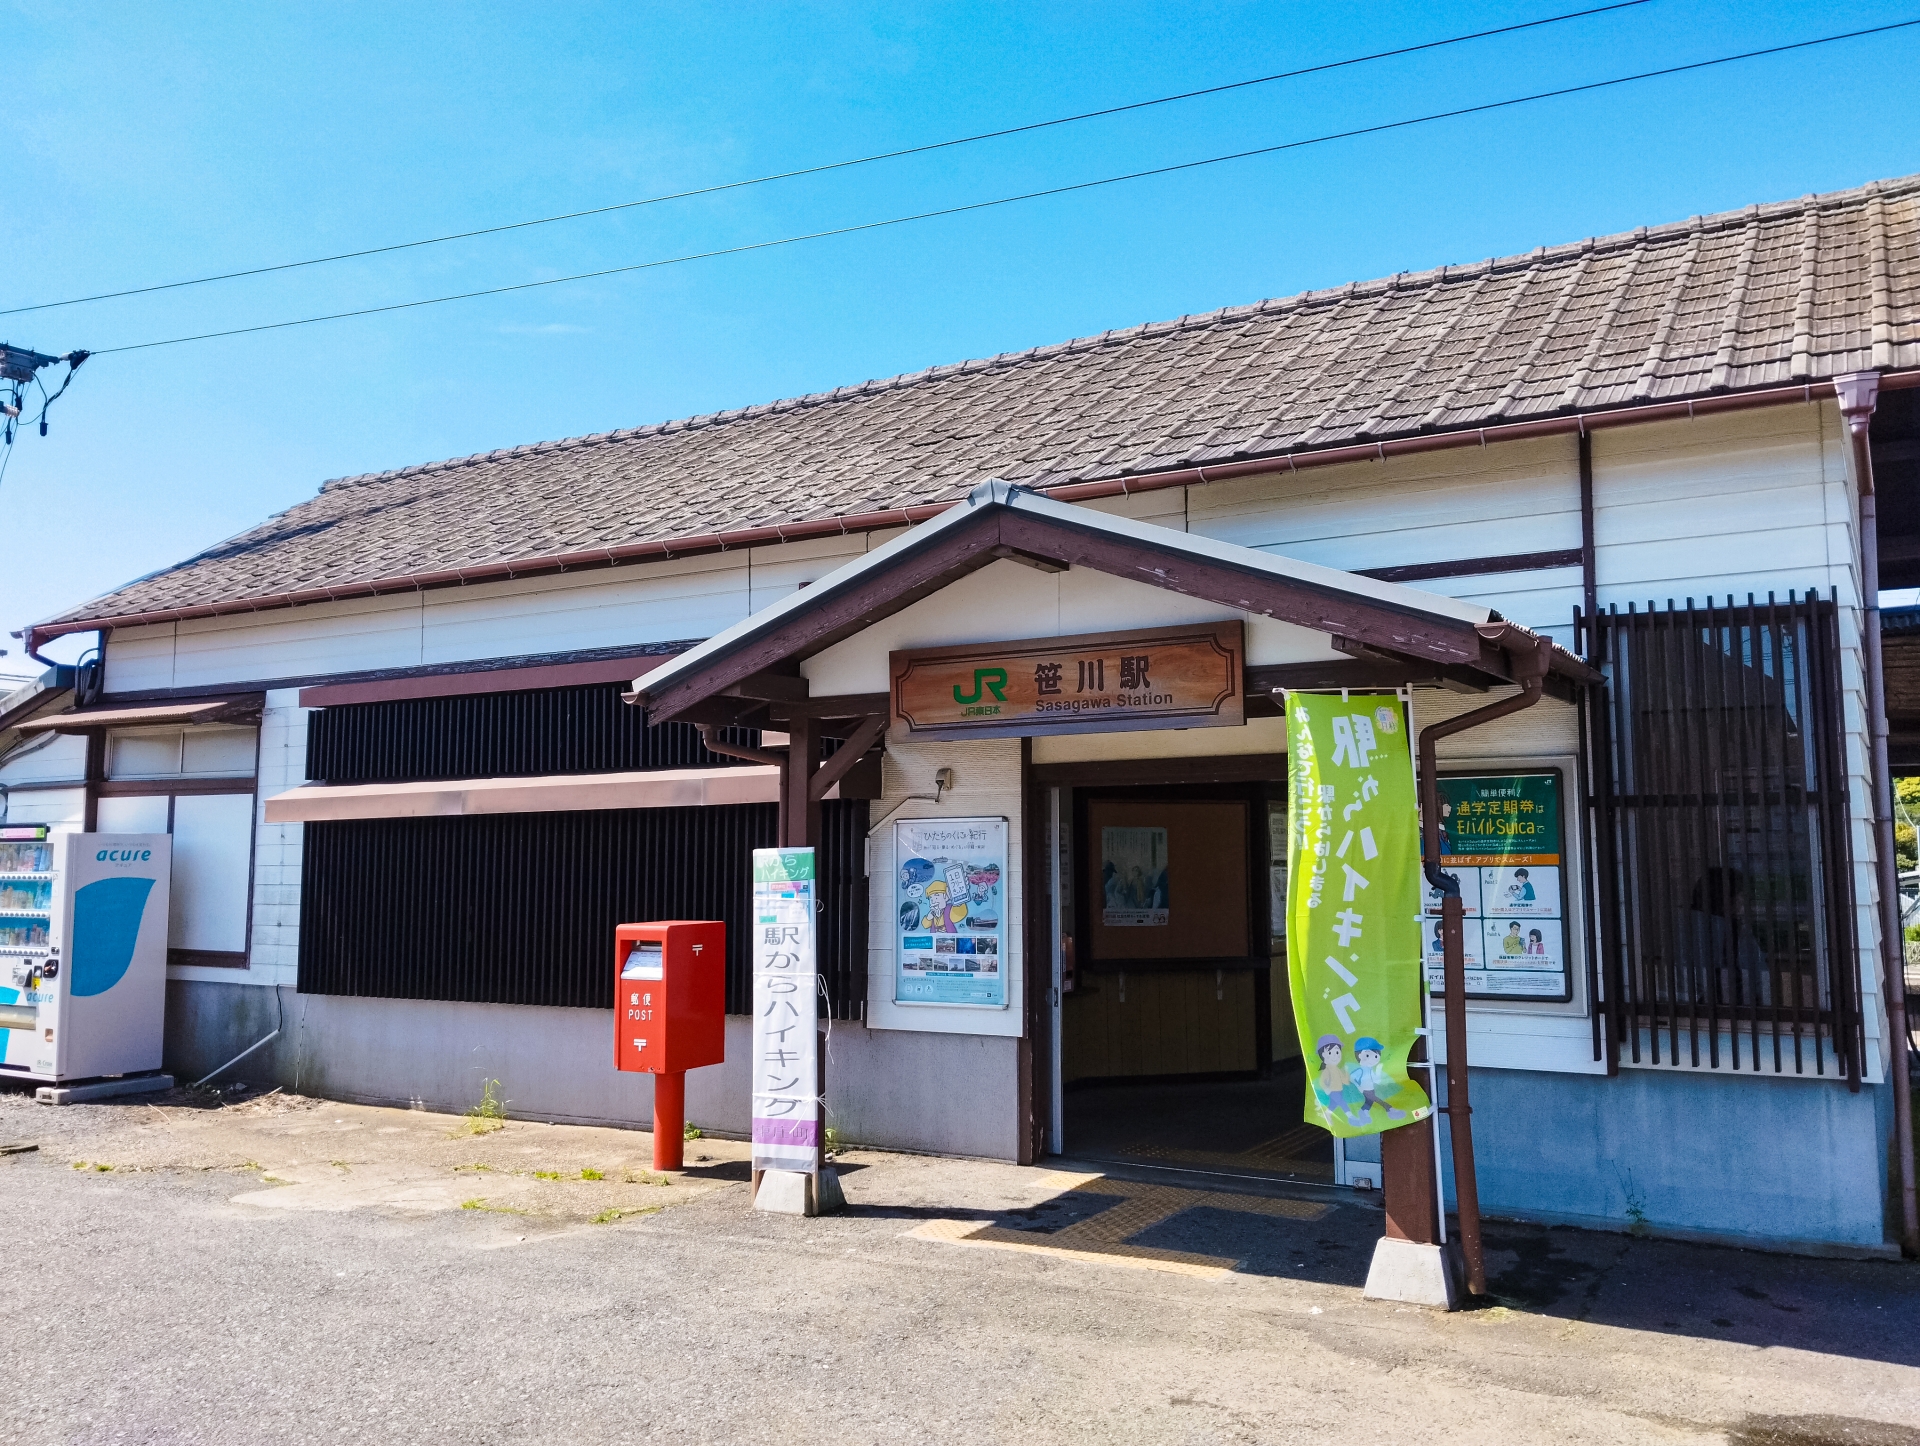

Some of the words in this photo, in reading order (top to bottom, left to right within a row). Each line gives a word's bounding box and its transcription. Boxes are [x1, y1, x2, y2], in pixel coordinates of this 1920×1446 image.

[1034, 655, 1152, 695] 笹川駅
[952, 667, 1008, 705] JR
[1035, 696, 1111, 714] Sasagawa
[1116, 692, 1173, 707] Station
[960, 704, 1002, 717] JR東日本
[1456, 799, 1545, 816] 通学定期券は
[1457, 817, 1545, 835] モバイルSuicaで
[96, 849, 151, 862] acure
[756, 854, 797, 868] 駅から
[761, 866, 810, 880] ハイキング
[26, 992, 54, 1003] acure
[630, 992, 652, 1006] 郵便
[628, 1009, 653, 1021] POST
[763, 925, 801, 1118] 駅からハイキング
